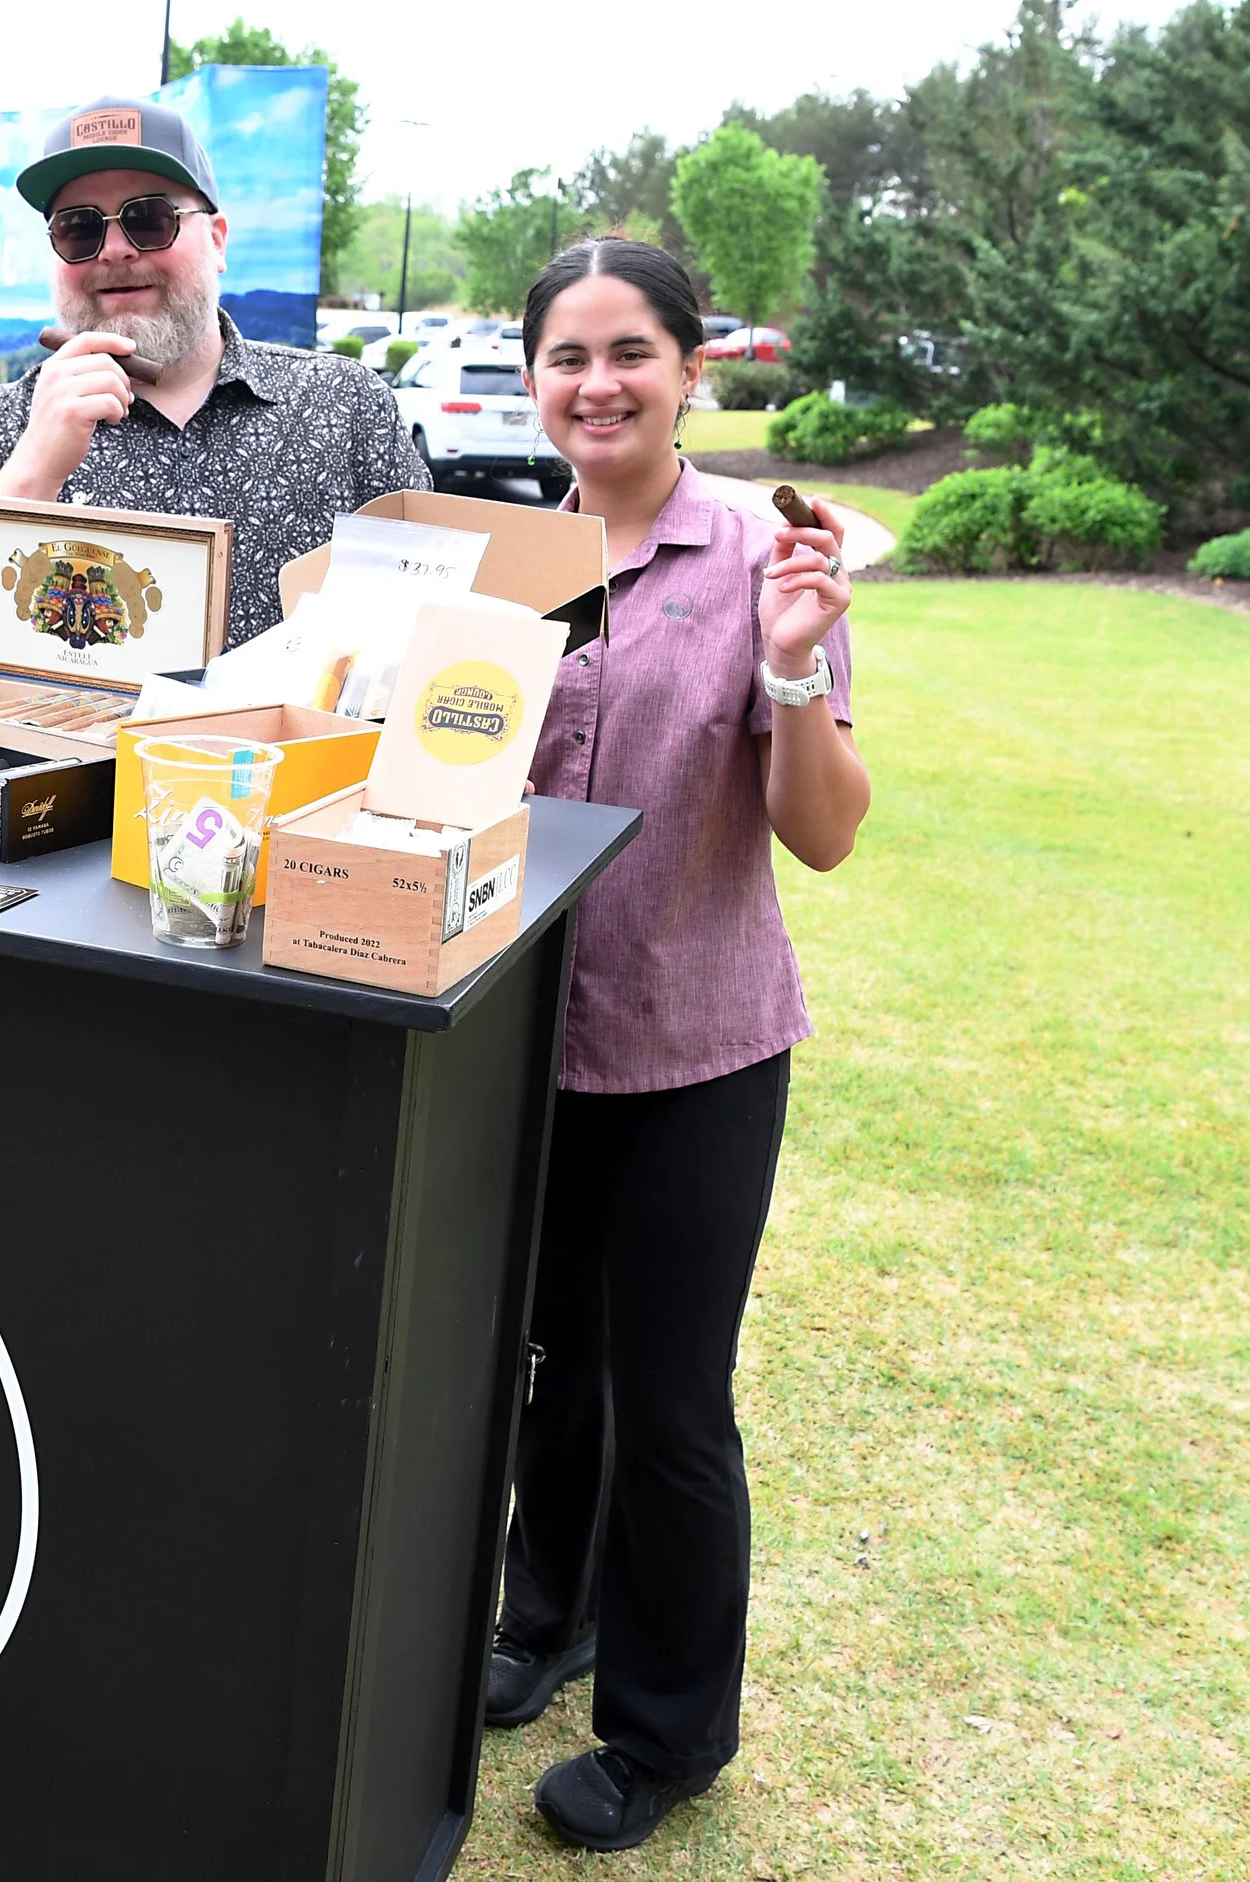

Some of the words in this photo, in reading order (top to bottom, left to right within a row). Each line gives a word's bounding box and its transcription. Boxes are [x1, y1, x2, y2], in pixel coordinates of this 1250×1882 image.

[76, 117, 136, 137] CASTILLO
[398, 559, 458, 580] $37.95
[437, 695, 465, 707] CIGAR
[455, 687, 491, 699] LOUNGE
[467, 700, 504, 713] MOBILE
[431, 709, 500, 733] CASTILLO
[186, 808, 223, 850] 5
[284, 859, 297, 870] 20
[300, 861, 350, 880] CIGARS
[468, 877, 496, 913] SNBN
[319, 930, 359, 945] Produced
[360, 938, 380, 949] 2022
[303, 939, 348, 955] Tabacalera
[371, 952, 407, 966] Cabrera
